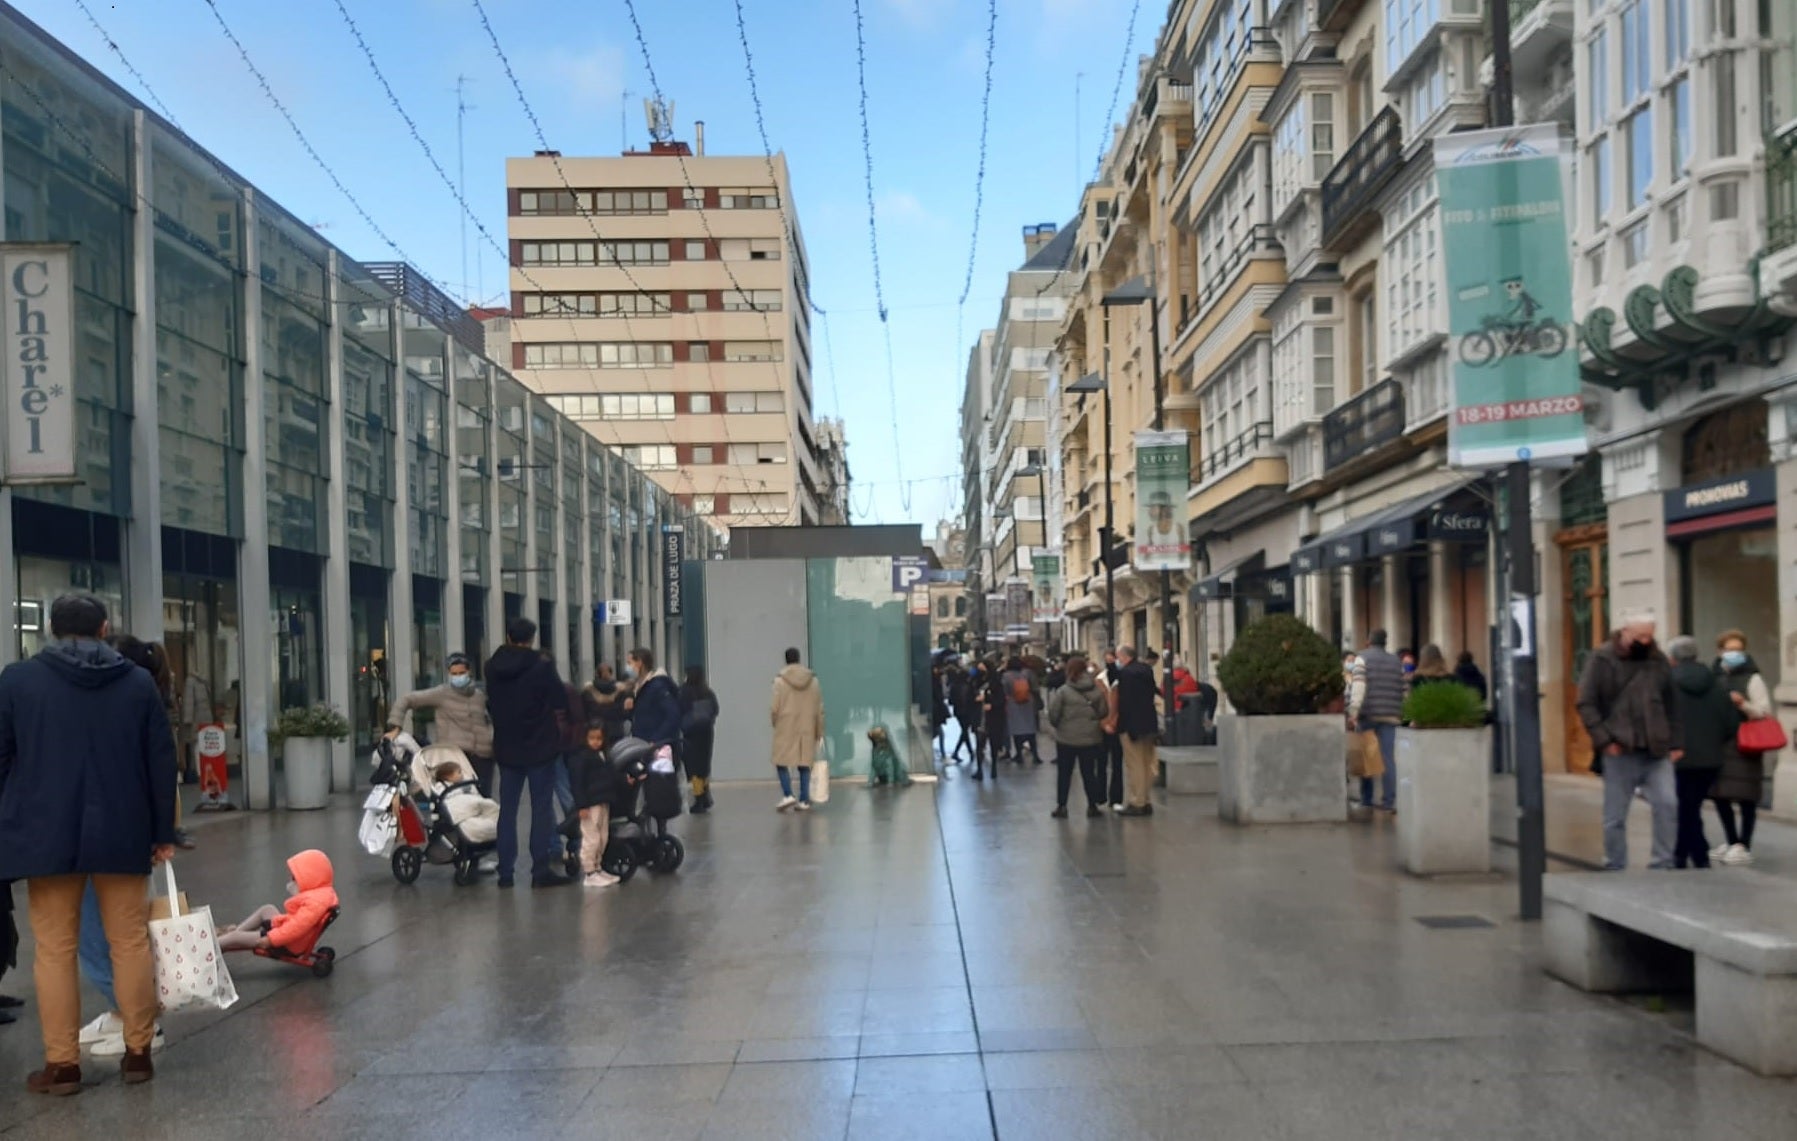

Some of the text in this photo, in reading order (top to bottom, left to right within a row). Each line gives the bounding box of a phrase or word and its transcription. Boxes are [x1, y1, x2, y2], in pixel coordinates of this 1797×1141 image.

[12, 260, 50, 453] Charel
[1458, 396, 1580, 424] 18-19 MARZO
[1685, 480, 1748, 508] PRONOVIAS
[1442, 512, 1481, 529] Sfera
[668, 535, 680, 613] PRAZA DE LUGO
[901, 566, 922, 587] P
